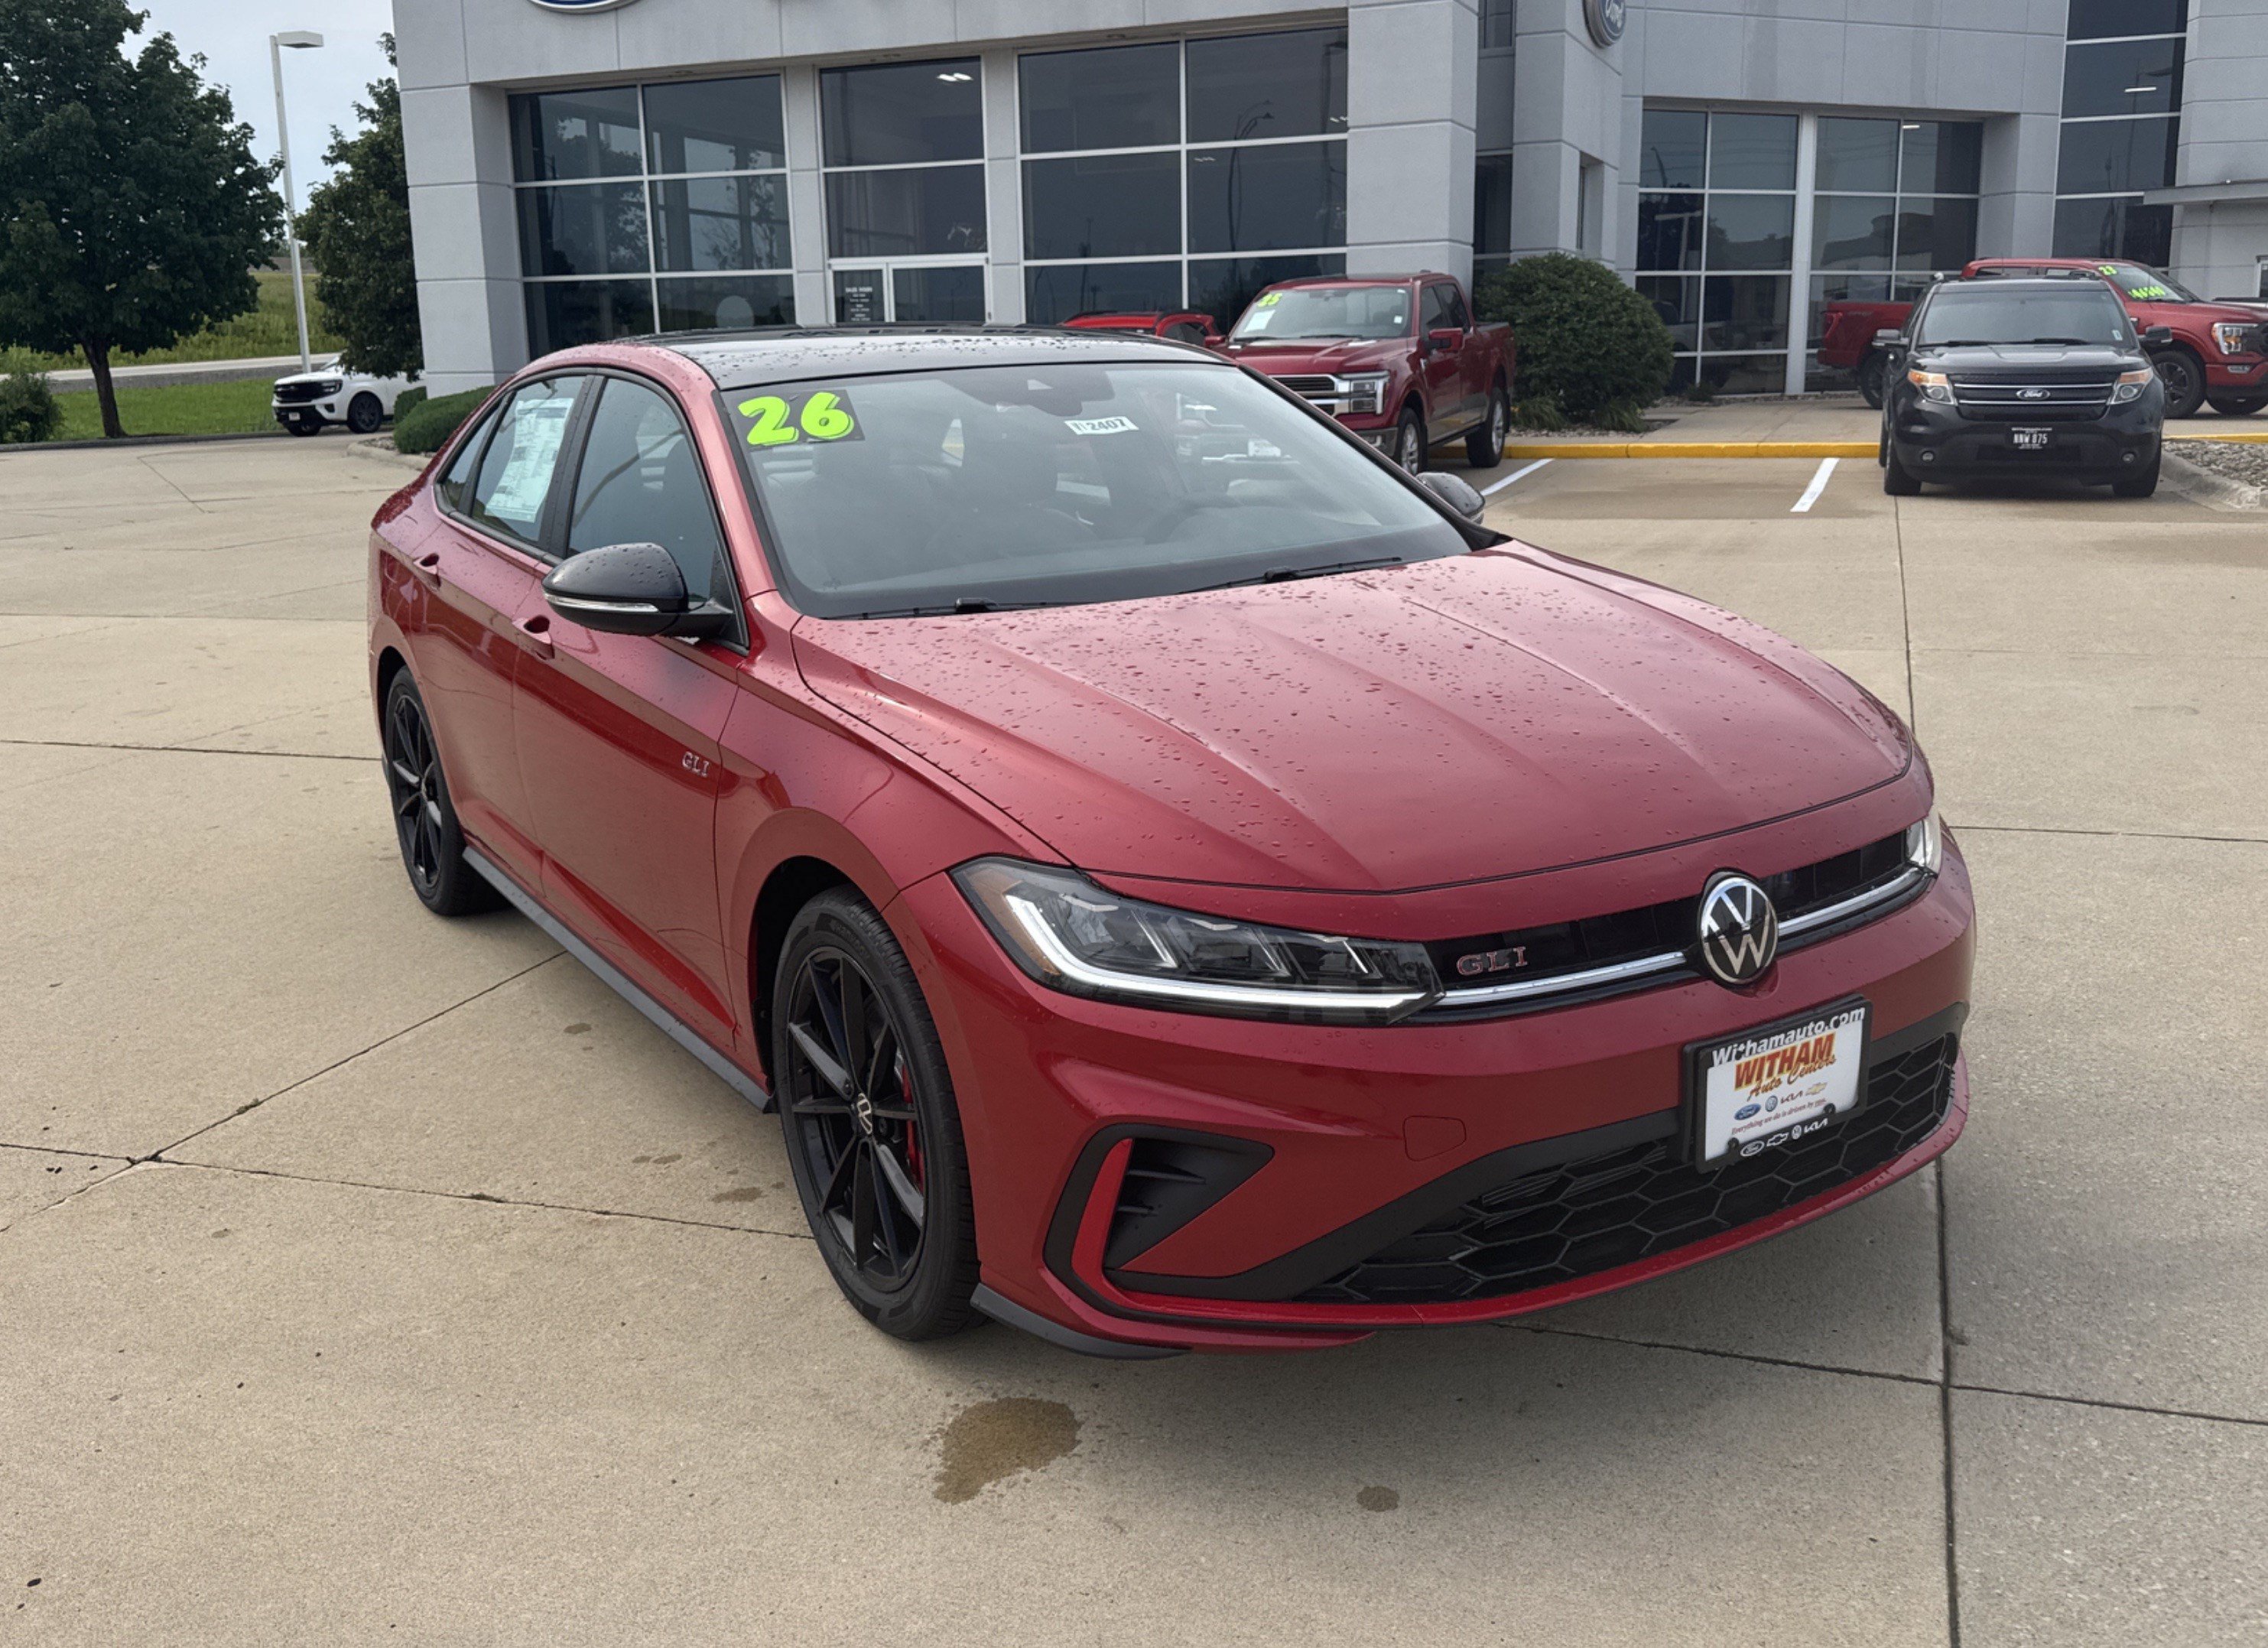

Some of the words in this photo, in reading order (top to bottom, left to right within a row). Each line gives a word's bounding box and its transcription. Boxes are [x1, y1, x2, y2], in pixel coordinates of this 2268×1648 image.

[737, 392, 854, 446] 26
[682, 751, 710, 778] GLI
[1457, 945, 1529, 977] GLI
[1734, 1032, 1836, 1091] WITHAM
